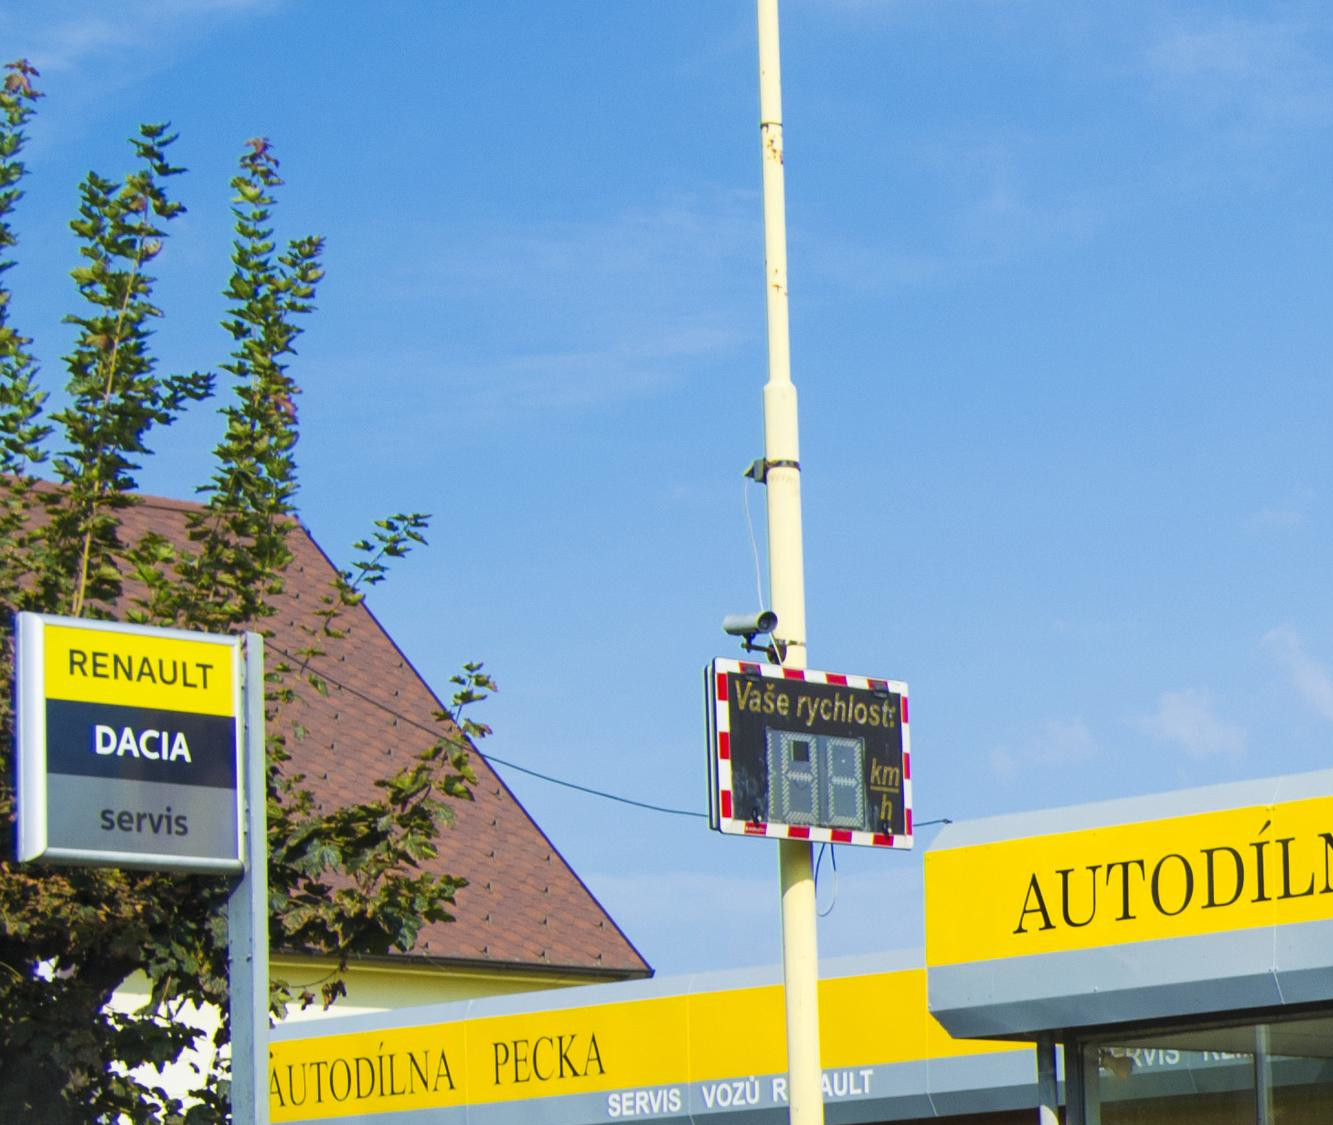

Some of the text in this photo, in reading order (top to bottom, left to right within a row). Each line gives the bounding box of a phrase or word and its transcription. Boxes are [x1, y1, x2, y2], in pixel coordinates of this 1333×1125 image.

[68, 649, 213, 689] RENAULT
[735, 679, 897, 728] Vaše rychlost:
[94, 724, 192, 763] DACIA
[869, 758, 900, 788] km
[100, 806, 188, 837] servis
[880, 793, 893, 821] h
[269, 1032, 606, 1107] AUTODÍLNA PECKA
[607, 1069, 873, 1118] SERVIS VOZŮ RAULT
